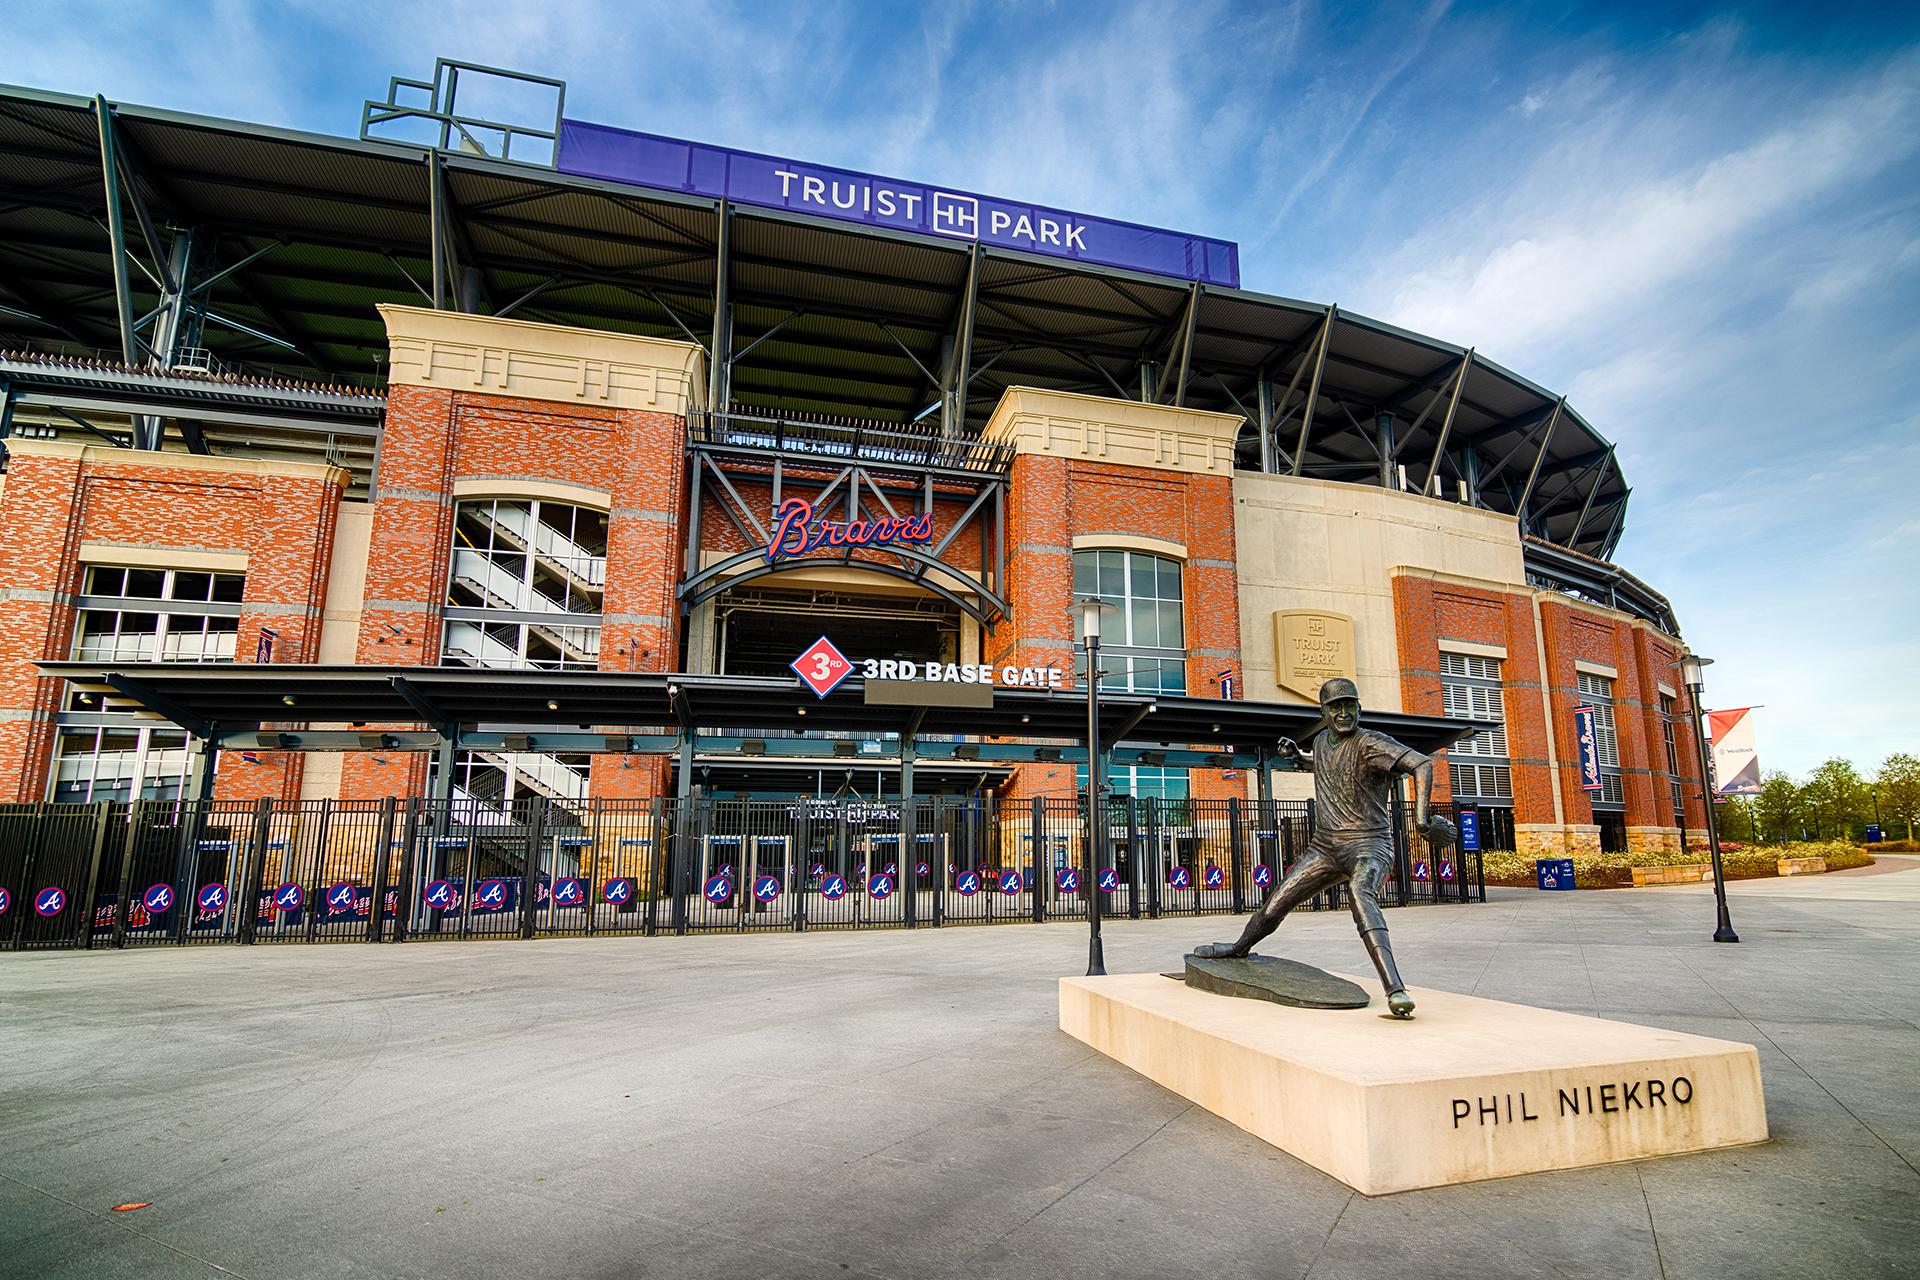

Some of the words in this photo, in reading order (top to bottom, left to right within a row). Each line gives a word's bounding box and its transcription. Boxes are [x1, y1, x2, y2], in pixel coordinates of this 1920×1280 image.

[774, 170, 922, 220] TRUIST
[991, 210, 1087, 250] PARK
[766, 497, 933, 561] Braves
[1293, 638, 1342, 652] TRUIST
[1300, 653, 1336, 666] PARK
[862, 658, 917, 681] 3RD
[925, 661, 994, 684] BASE
[1002, 665, 1062, 688] GATE
[1451, 1092, 1539, 1129] PHIL
[1558, 1076, 1694, 1117] NIEKRO
